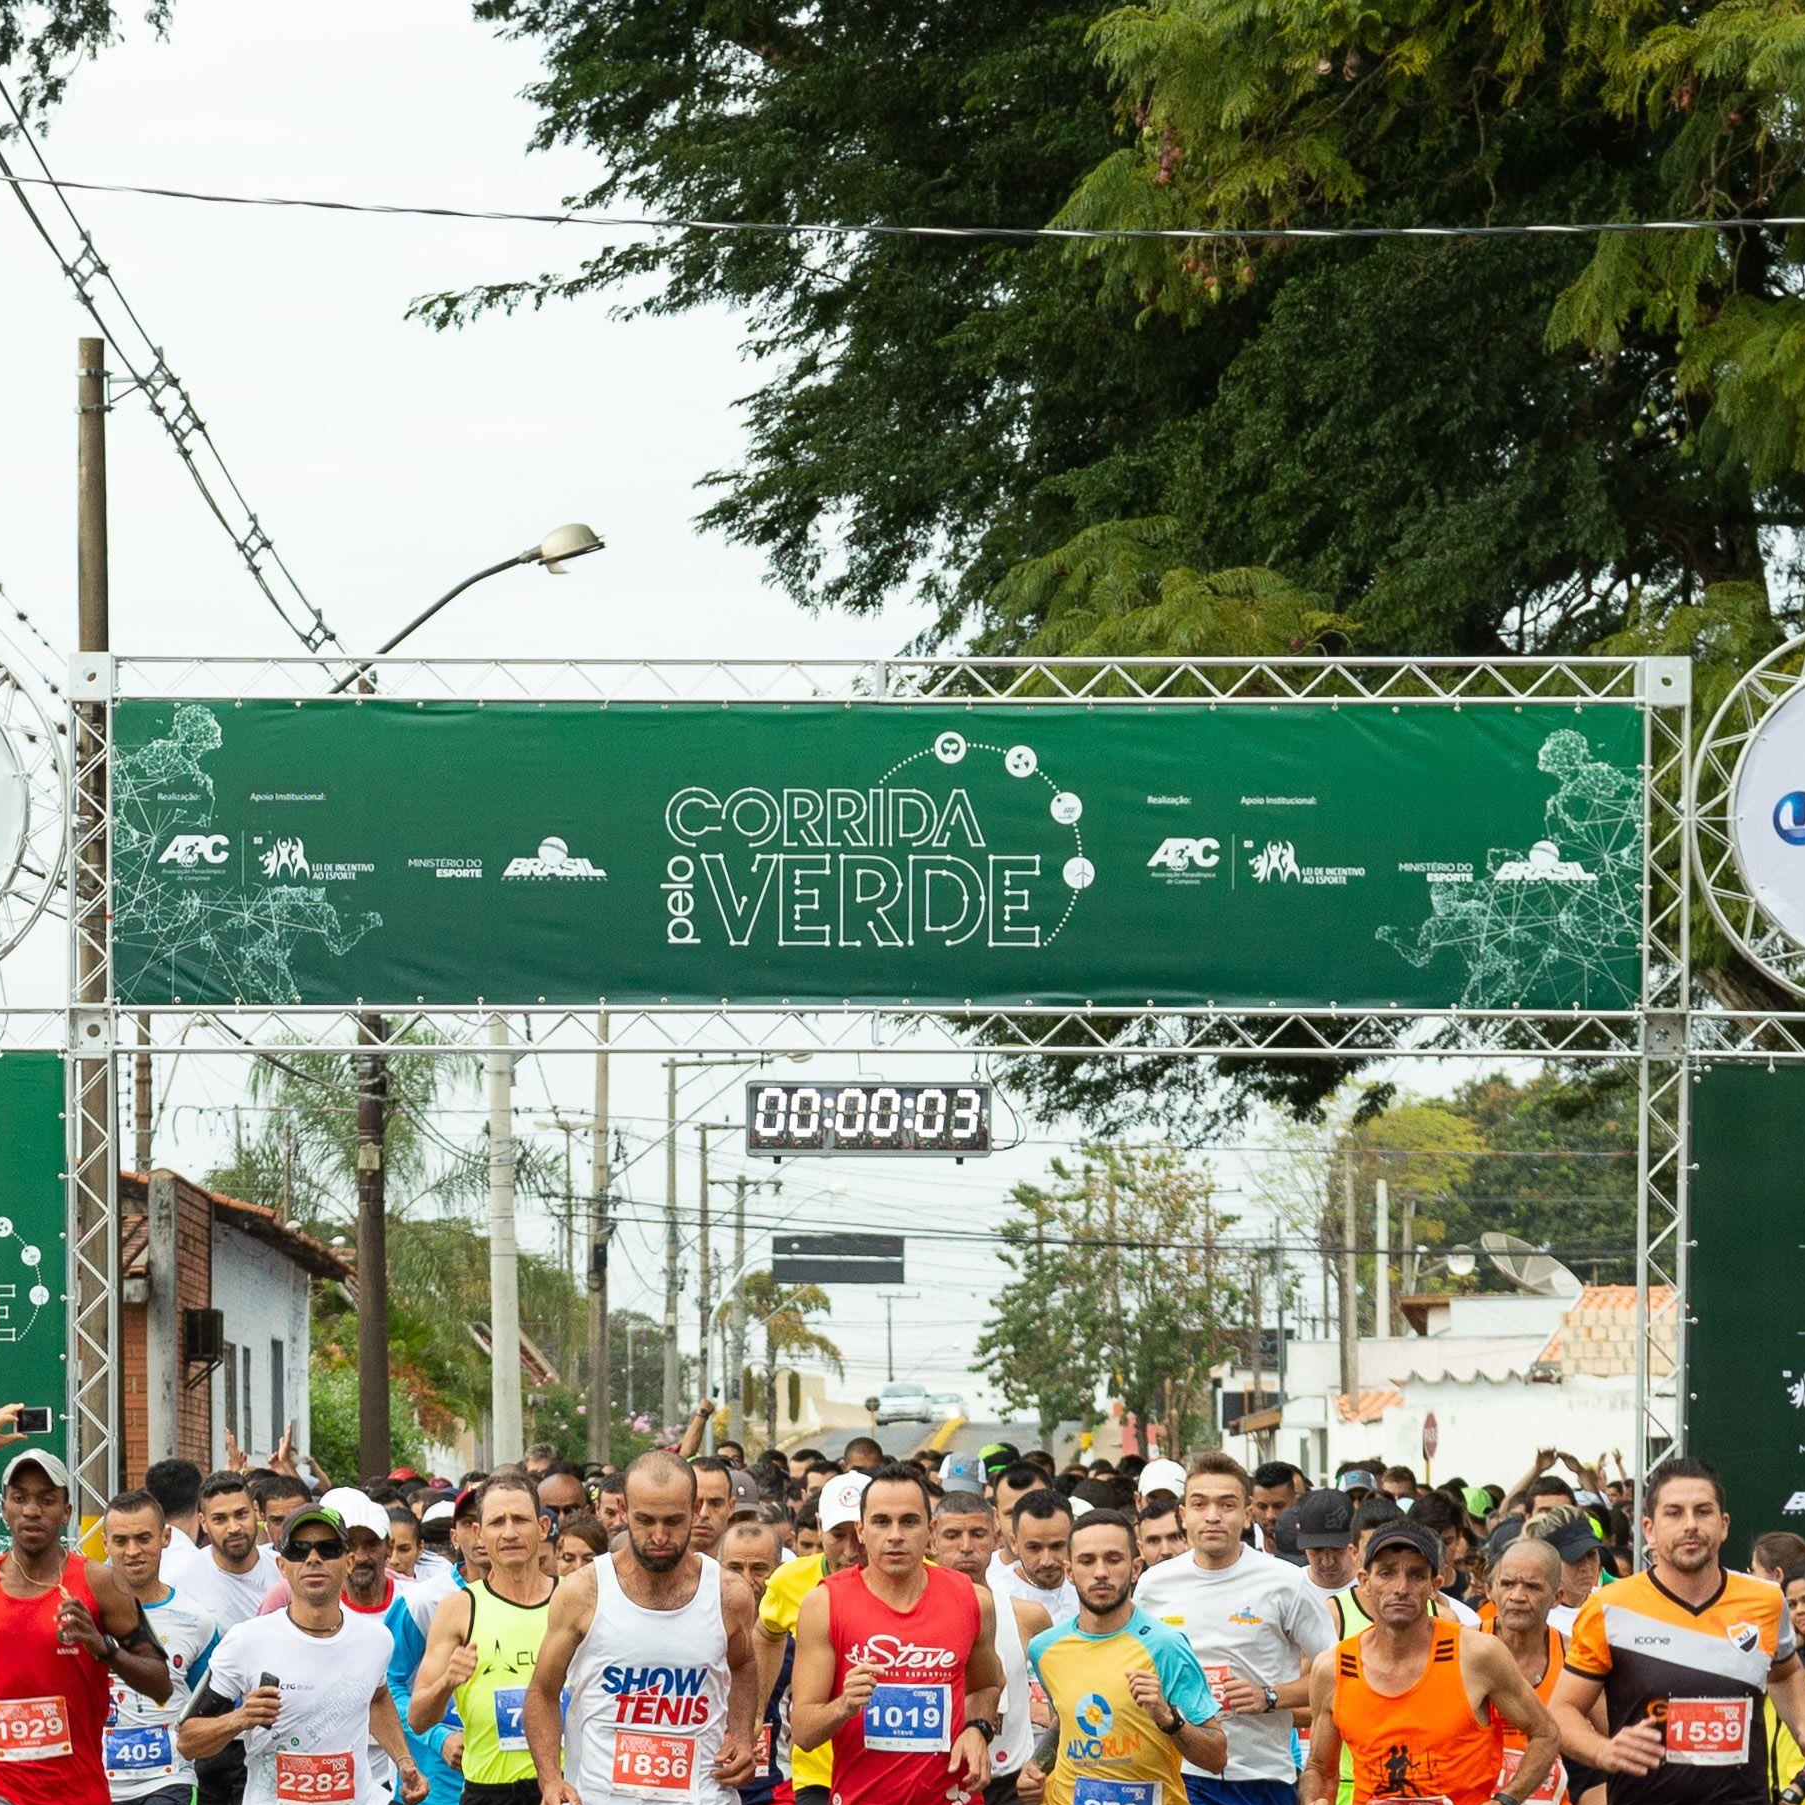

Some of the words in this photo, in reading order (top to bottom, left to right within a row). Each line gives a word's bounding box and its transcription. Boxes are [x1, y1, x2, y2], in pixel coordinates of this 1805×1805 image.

[157, 792, 201, 803] Realização:
[250, 792, 273, 803] Apoio
[275, 792, 326, 802] Institucional:
[1147, 795, 1192, 806] Realização:
[1240, 795, 1264, 806] Apoio
[1266, 795, 1317, 805] Institucional:
[665, 786, 986, 848] CORRIDA
[311, 863, 322, 872] LEI
[324, 863, 333, 872] DE
[335, 863, 375, 872] INCENTIVO
[408, 857, 464, 868] MINISTÉRIO
[466, 858, 482, 868] DO
[502, 857, 608, 877] BRASIL
[1398, 861, 1455, 872] MINISTÉRIO
[1457, 863, 1473, 872] DO
[312, 872, 323, 880] AO
[326, 872, 357, 880] ESPORTE
[435, 868, 482, 878] ESPORTE
[1302, 867, 1313, 876] LEI
[1314, 867, 1324, 876] DE
[1325, 867, 1365, 876] INCENTIVO
[1426, 873, 1474, 882] ESPORTE
[1494, 861, 1599, 881] BRASIL
[1302, 876, 1314, 884] AO
[1316, 876, 1347, 885] ESPORTE
[660, 855, 700, 944] pelo
[700, 853, 1041, 947] VERDE
[754, 1087, 981, 1138] 00:00:03
[1634, 1635, 1671, 1645] icone
[867, 1633, 958, 1669] Steve
[601, 1665, 709, 1697] SHOW
[867, 1705, 940, 1728] 1019
[1670, 1720, 1742, 1742] 1539
[115, 1742, 162, 1762] 405
[616, 1753, 688, 1779] 1836
[279, 1771, 351, 1793] 2282
